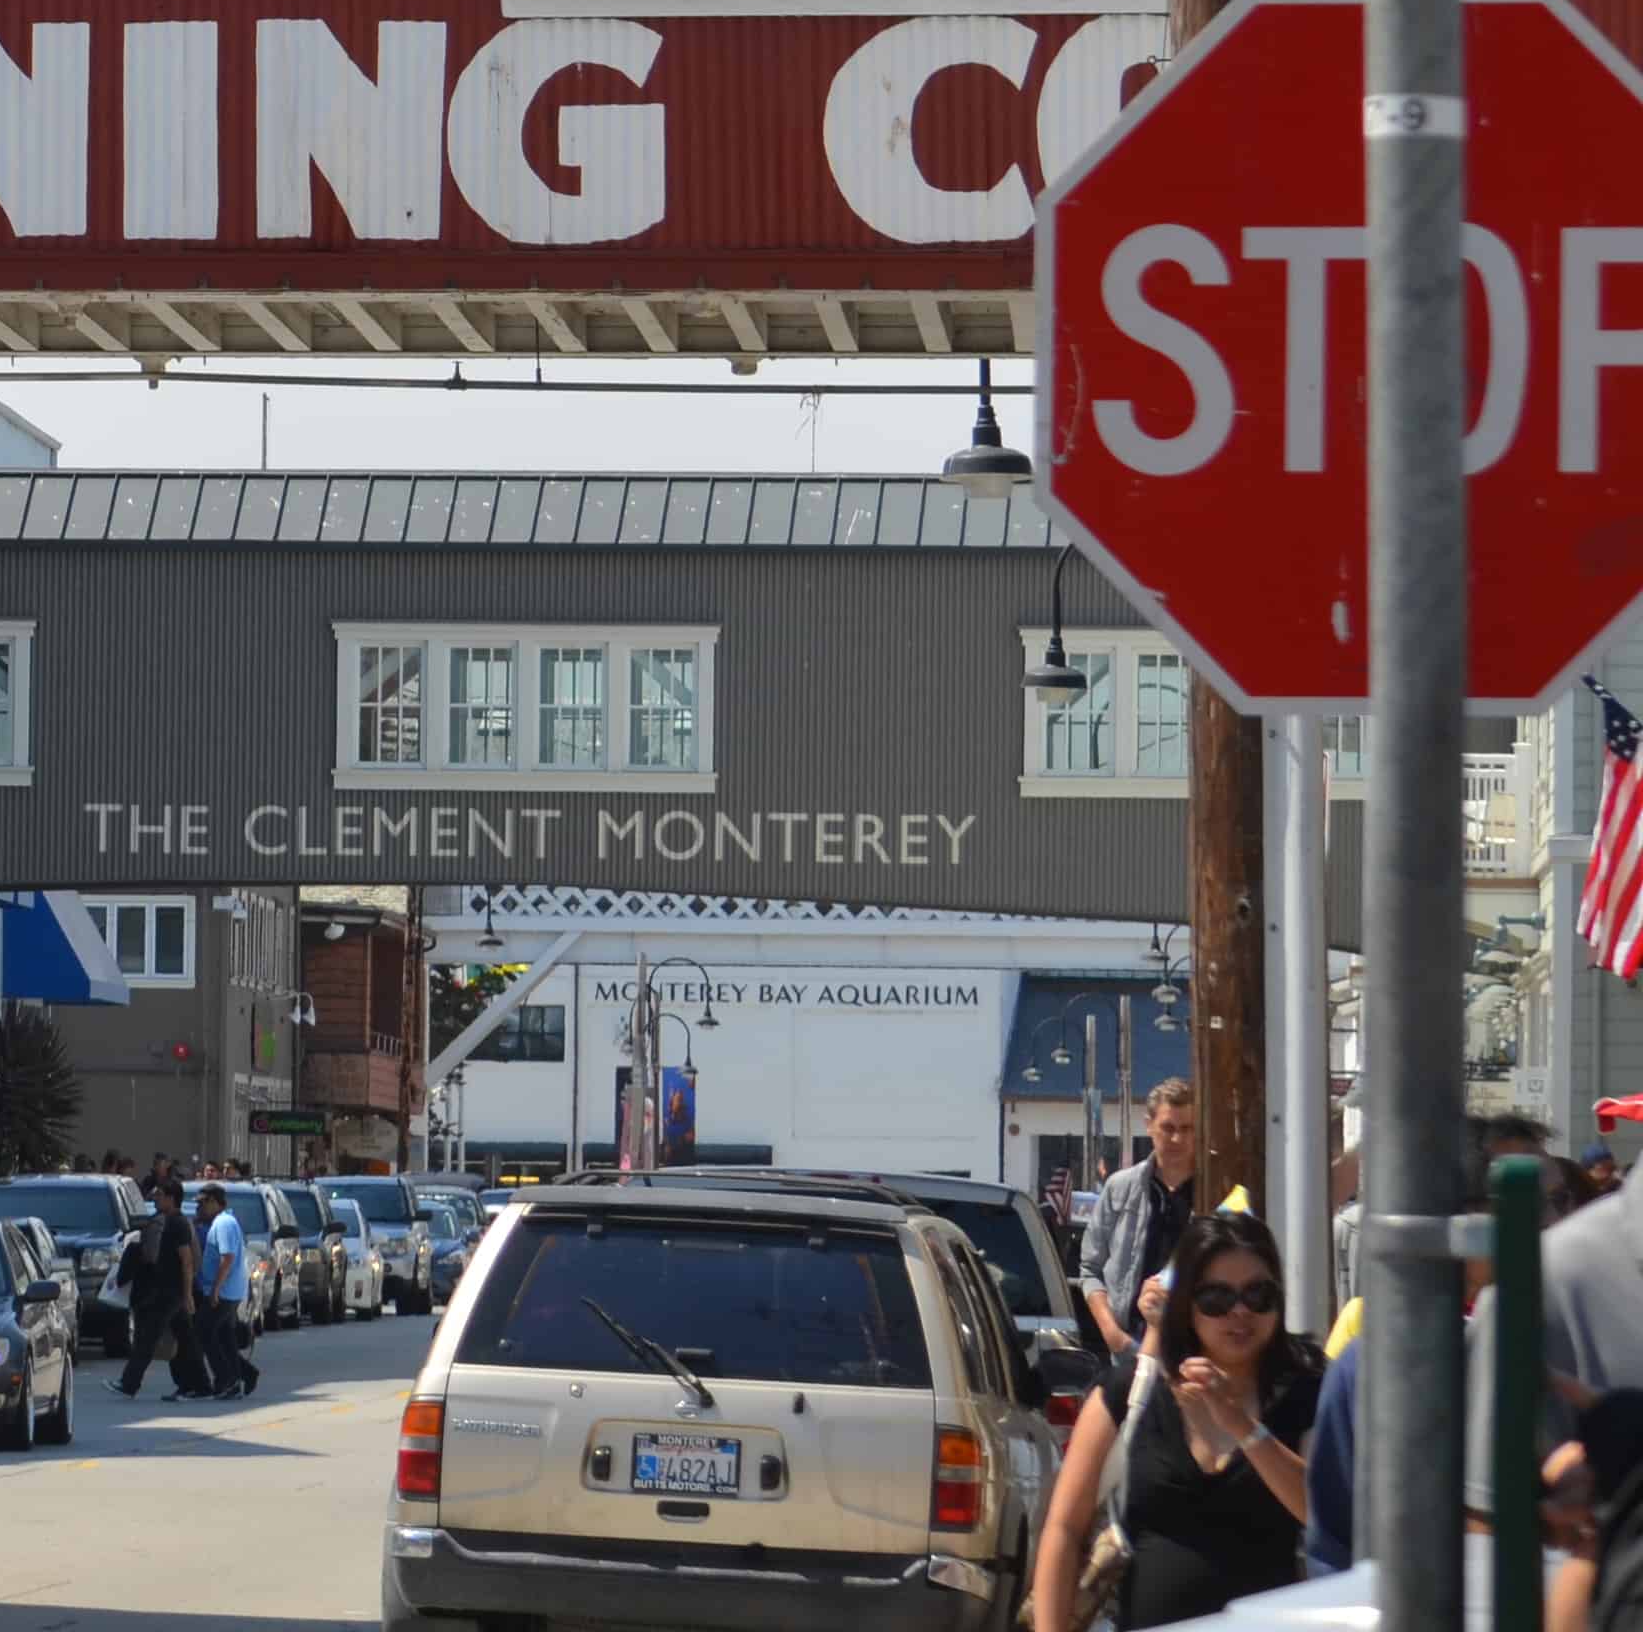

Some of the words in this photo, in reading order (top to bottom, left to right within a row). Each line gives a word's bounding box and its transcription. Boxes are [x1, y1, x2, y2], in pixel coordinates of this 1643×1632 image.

[85, 803, 209, 855] THE
[244, 805, 561, 859] CLEMENT
[598, 809, 976, 865] MONTEREY
[595, 981, 747, 1003] MONTEREY
[757, 983, 809, 1004] BAY
[817, 984, 979, 1006] AQUARIUM
